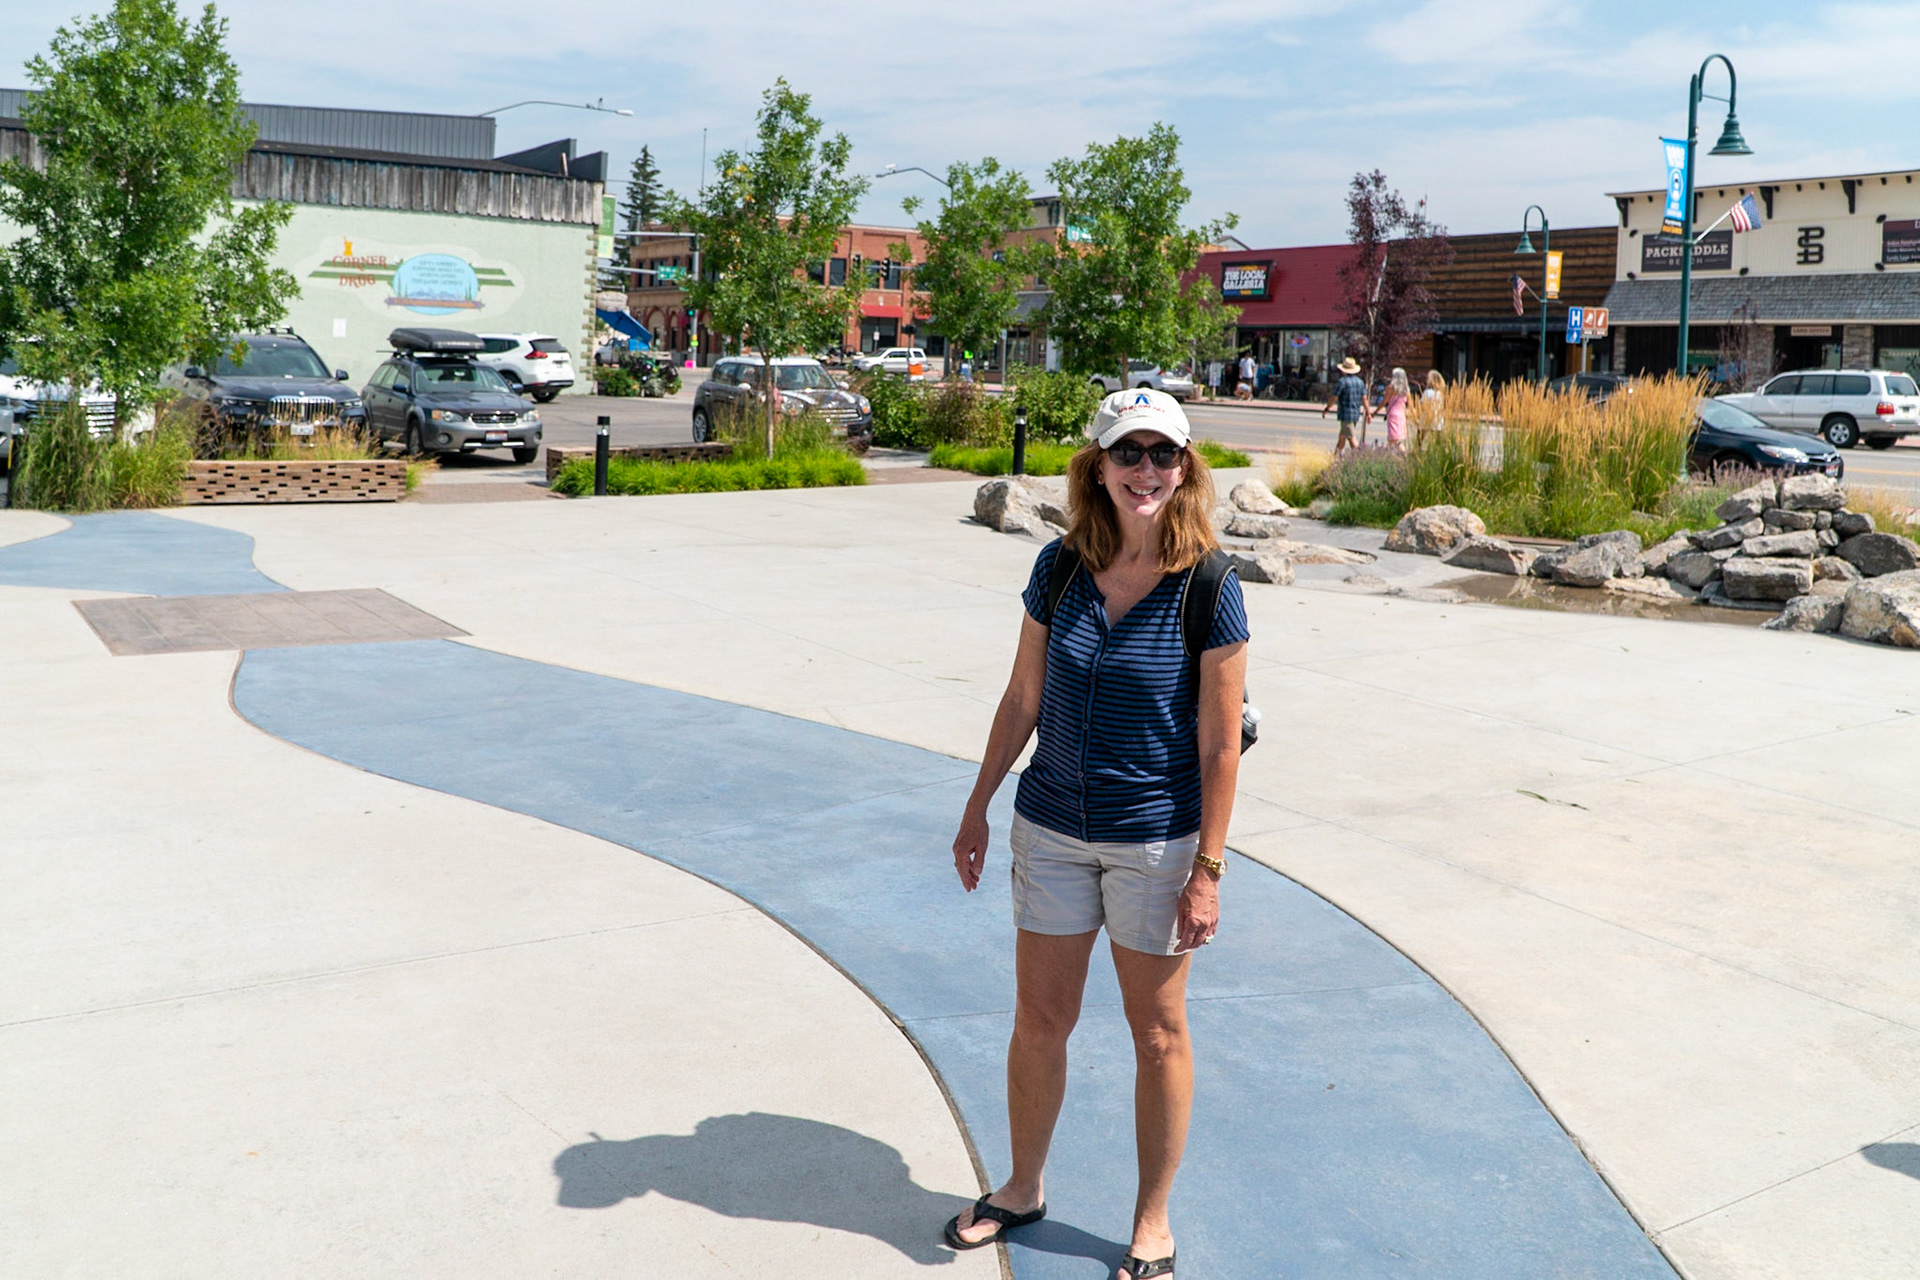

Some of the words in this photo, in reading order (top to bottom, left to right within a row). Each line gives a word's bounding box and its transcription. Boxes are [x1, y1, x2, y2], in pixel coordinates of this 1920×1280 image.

[1646, 244, 1728, 258] PACKSDDLE
[332, 255, 388, 271] CORNER
[1669, 258, 1703, 266] BECH
[339, 273, 376, 288] DRUG
[1225, 271, 1239, 281] THE
[1240, 270, 1266, 280] LOCAL
[1572, 310, 1580, 326] H
